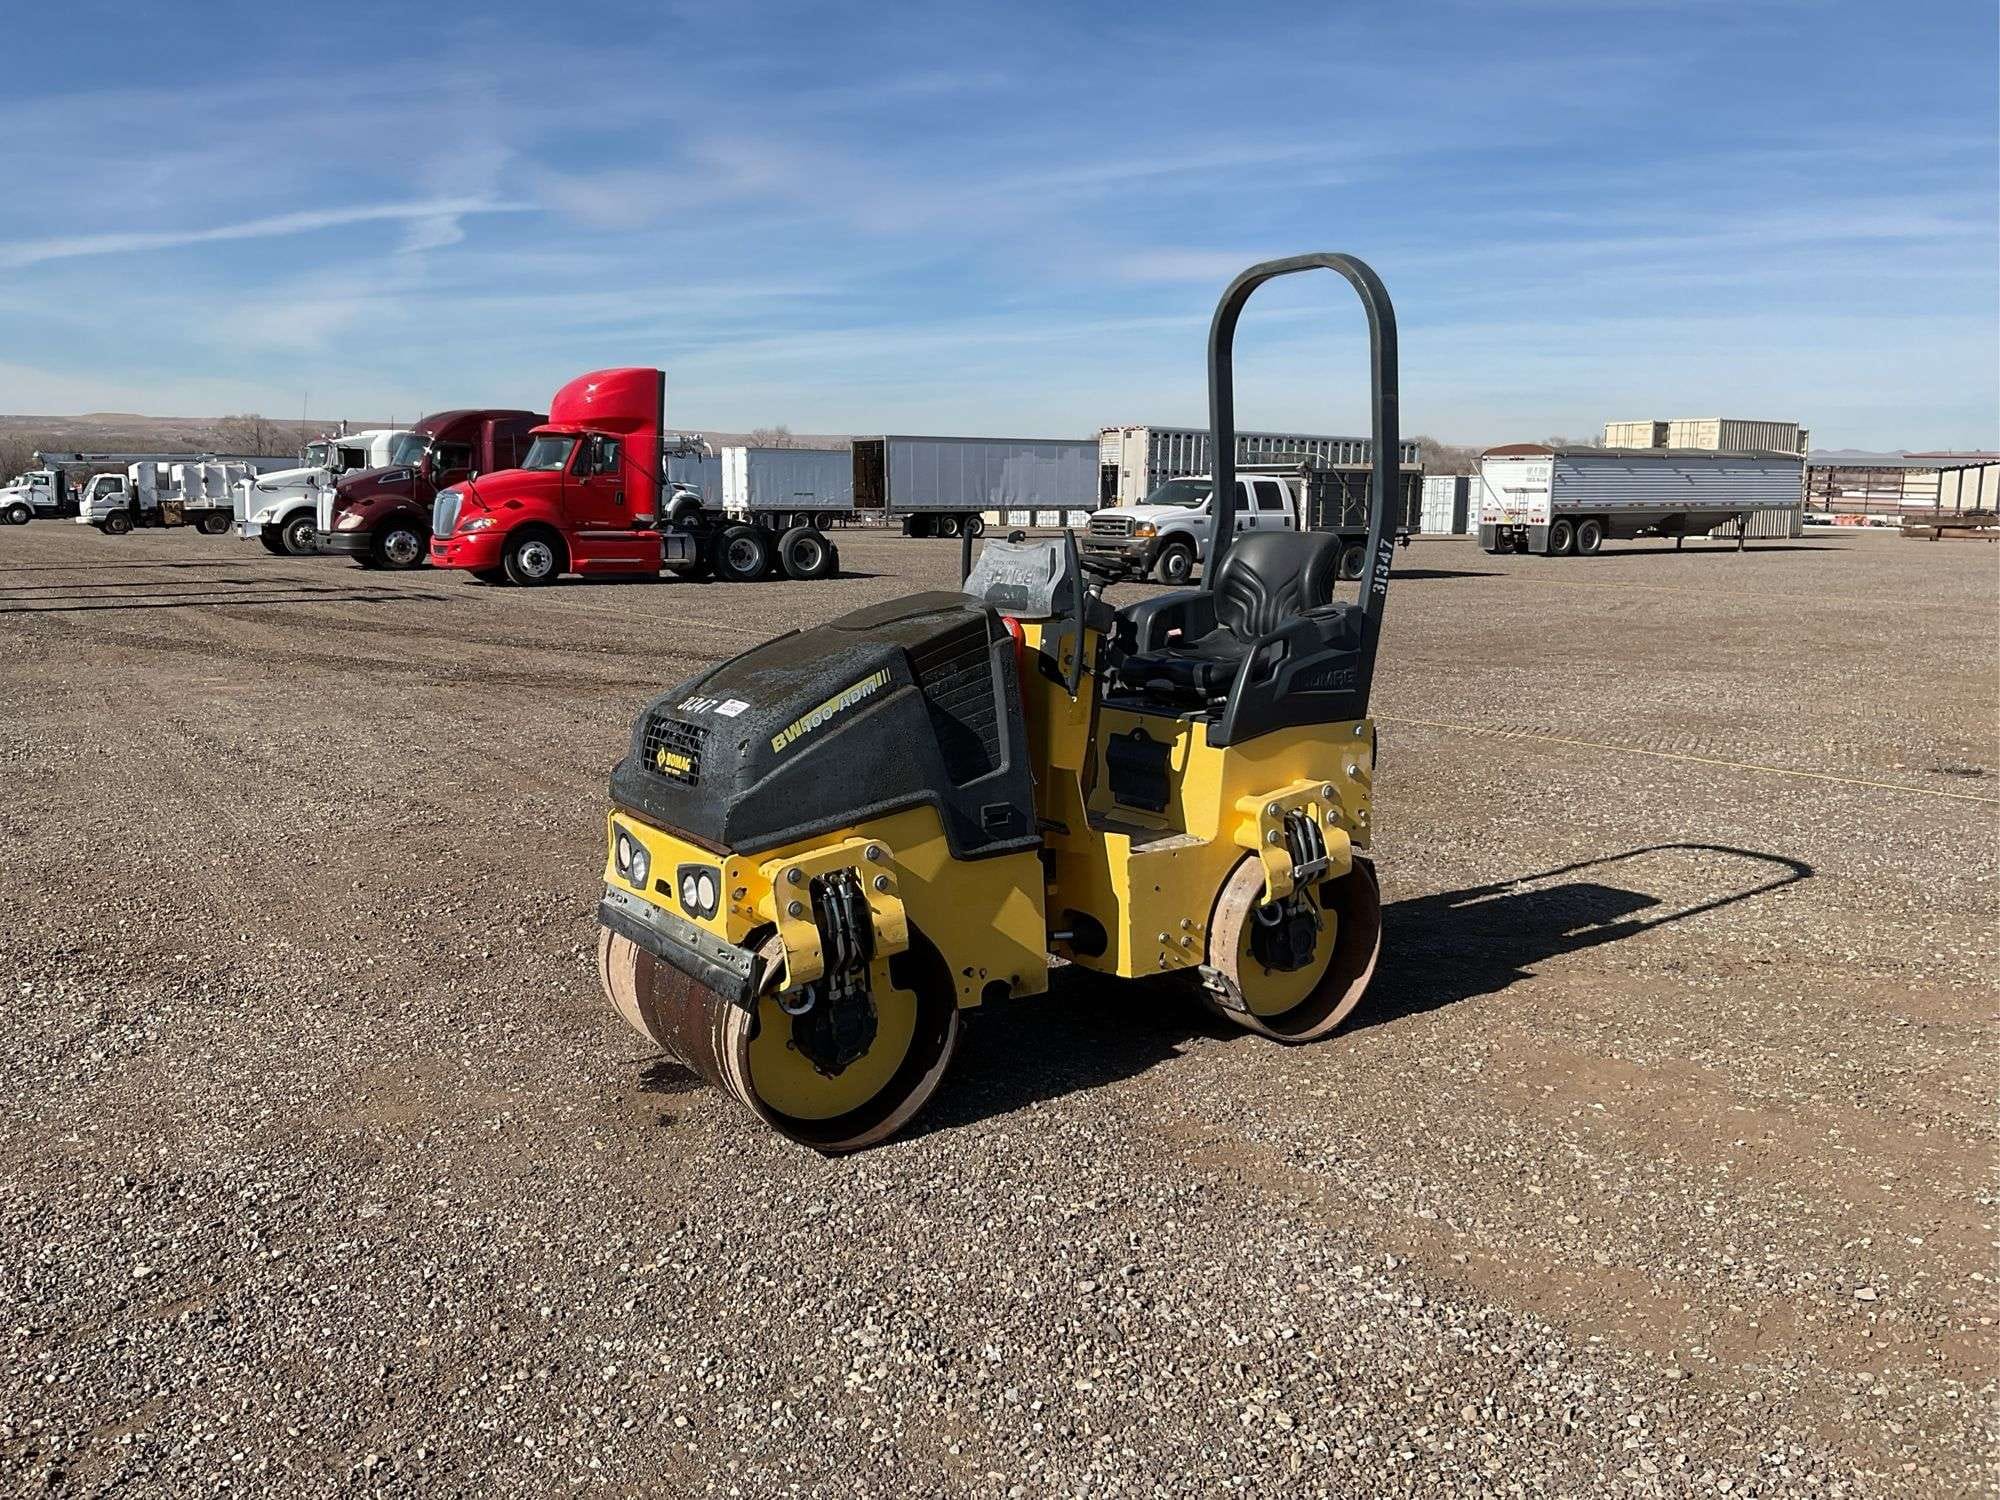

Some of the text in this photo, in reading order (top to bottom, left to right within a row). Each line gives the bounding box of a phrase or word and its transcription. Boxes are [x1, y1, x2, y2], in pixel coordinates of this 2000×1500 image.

[1373, 538, 1393, 594] 31347
[677, 696, 719, 714] 31347
[665, 752, 692, 772] BOMAG
